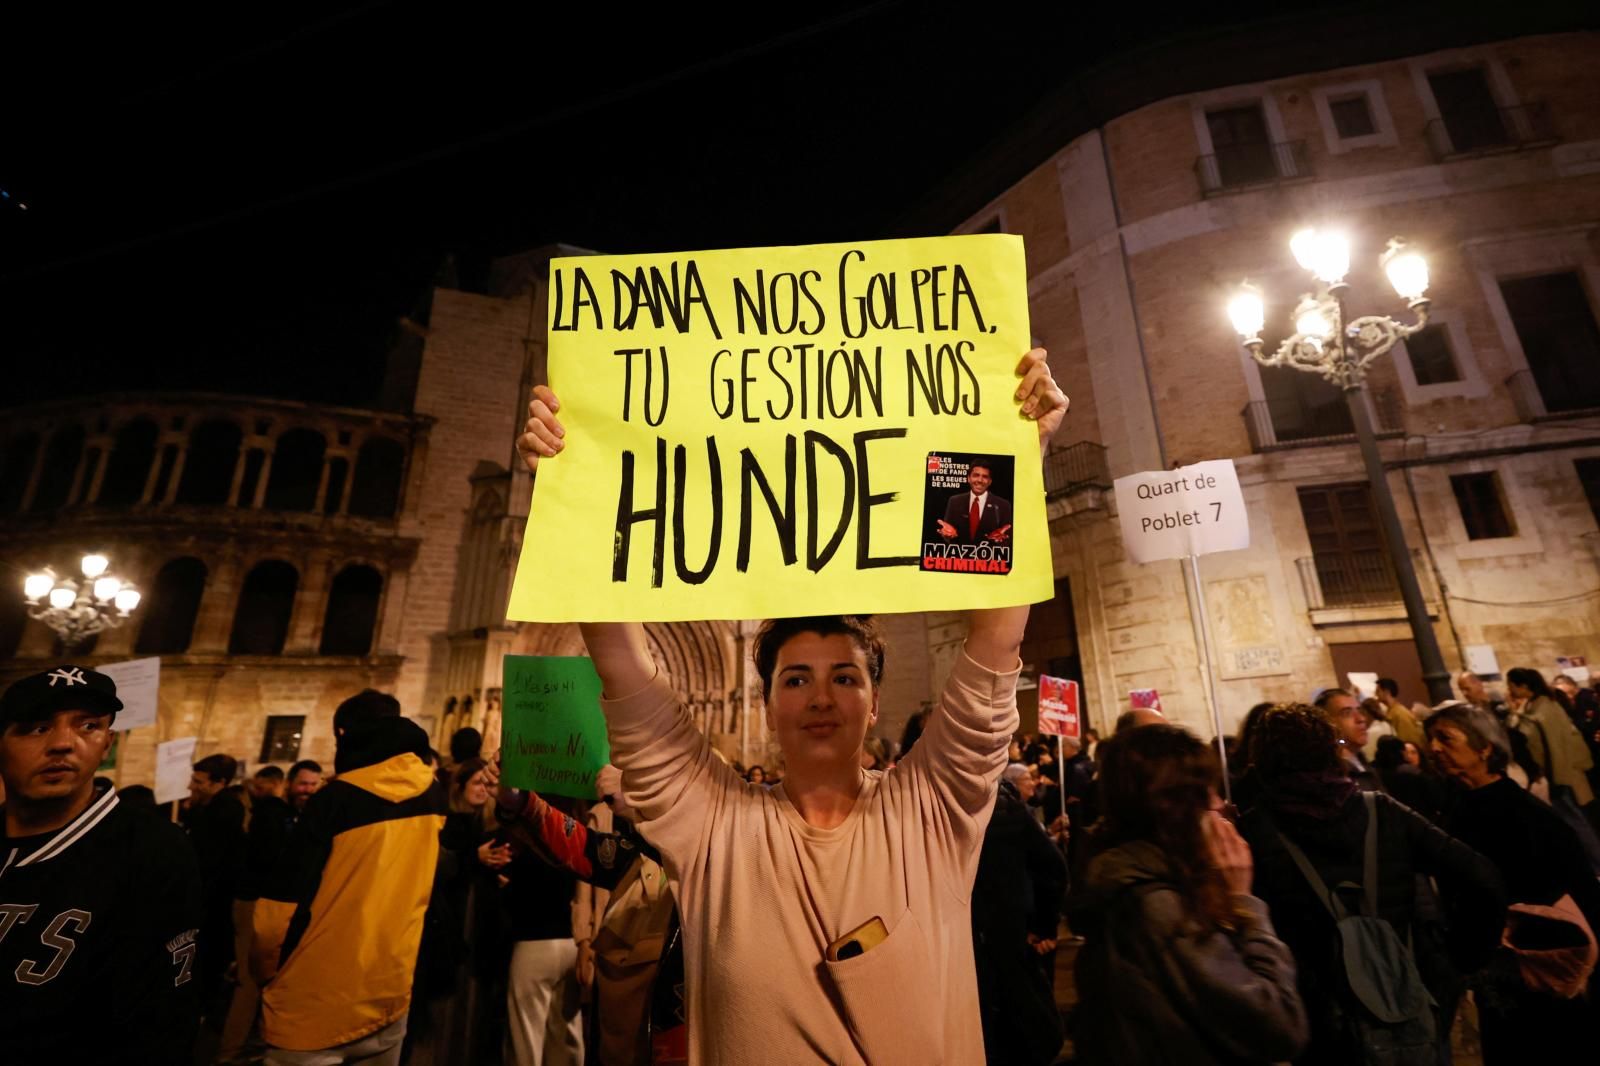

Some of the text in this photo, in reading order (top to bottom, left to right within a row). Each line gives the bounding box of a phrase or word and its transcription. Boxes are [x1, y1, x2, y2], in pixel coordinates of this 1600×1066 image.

[552, 250, 998, 340] LA DANA NOS GOLPEA,
[614, 341, 982, 427] TU GESTIÓN NOS
[1137, 473, 1216, 500] Quart de
[612, 428, 921, 588] HUNDE
[1141, 502, 1222, 533] Poblet 7
[923, 540, 1010, 563] MAZÓN
[923, 557, 1010, 573] CRIMINAL
